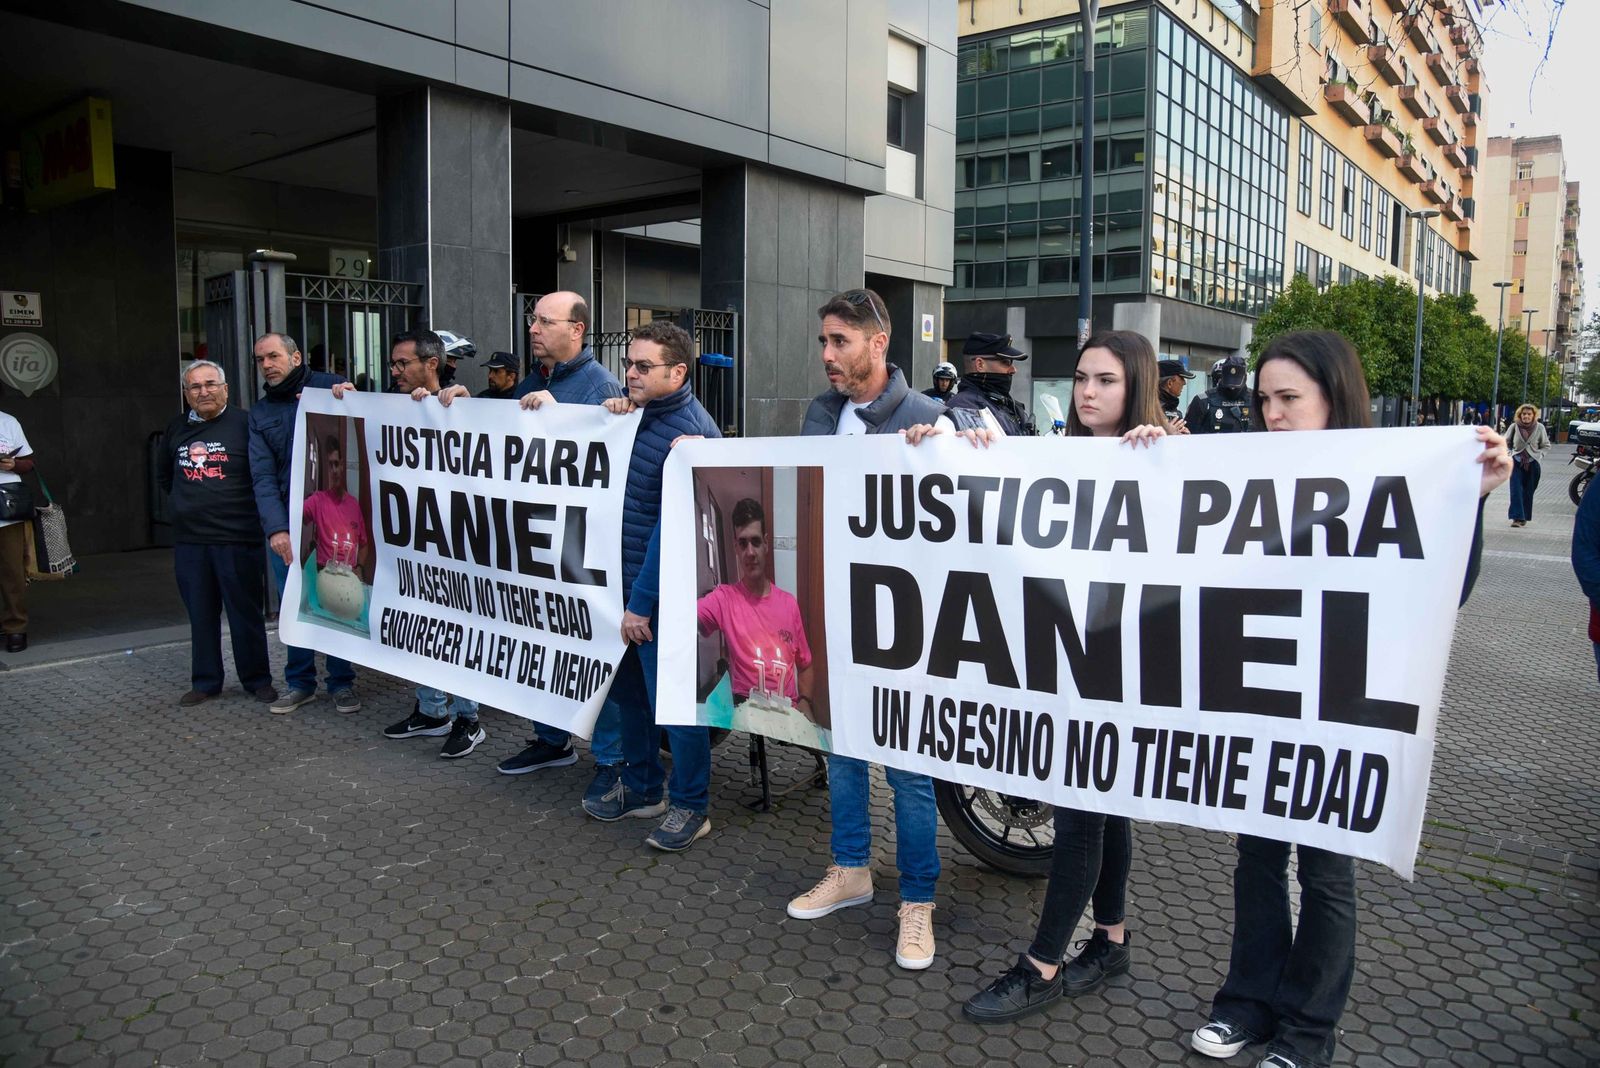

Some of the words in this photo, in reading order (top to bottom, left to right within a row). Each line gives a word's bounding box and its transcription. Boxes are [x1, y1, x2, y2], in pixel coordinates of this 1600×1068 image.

[335, 257, 365, 278] 29
[13, 356, 41, 374] ifa
[376, 425, 493, 479] JUSTICIA
[504, 435, 610, 488] PARA
[379, 479, 607, 587] DANIEL
[847, 472, 1148, 553] JUSTICIA
[1176, 475, 1425, 560] PARA
[397, 557, 415, 597] UN
[418, 562, 472, 613] ASESINO
[475, 576, 495, 619] NO
[497, 580, 544, 630] TIENE
[545, 591, 593, 641] EDAD
[380, 607, 463, 666] ENDURECER
[465, 628, 483, 670] LA
[486, 632, 518, 680] LEY
[517, 641, 546, 690] DEL
[850, 562, 1420, 735] DANIEL
[871, 685, 910, 750] UN
[916, 694, 1055, 781] ASESINO
[1063, 719, 1120, 792] NO
[1131, 727, 1254, 810] TIENE
[1263, 740, 1390, 833] EDAD
